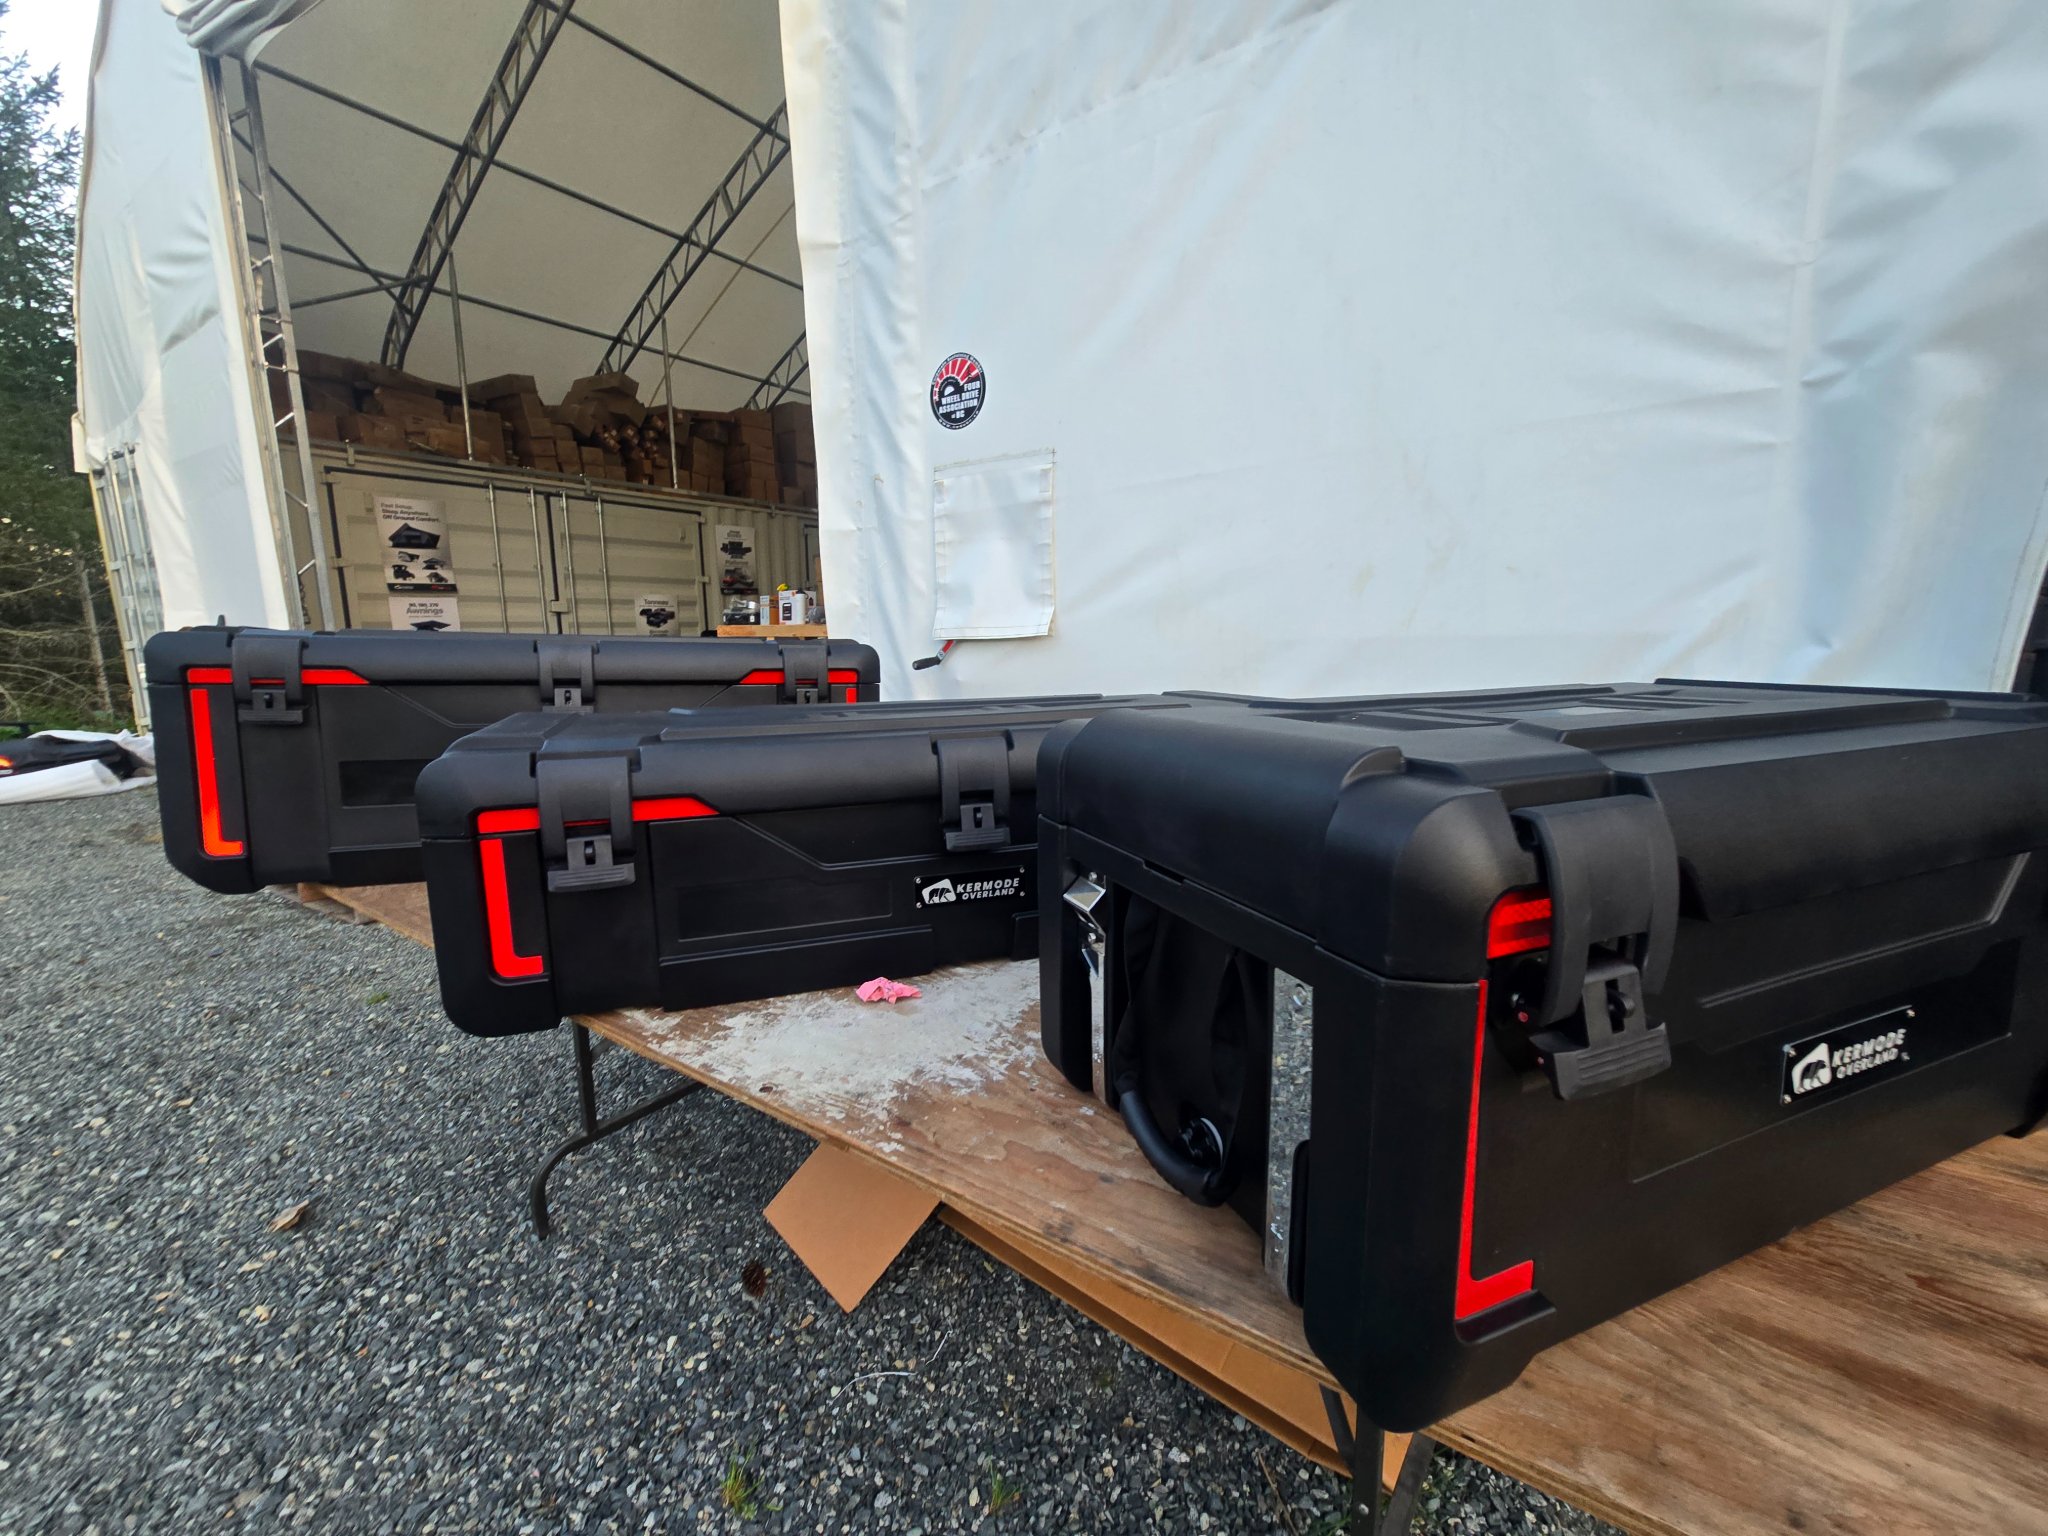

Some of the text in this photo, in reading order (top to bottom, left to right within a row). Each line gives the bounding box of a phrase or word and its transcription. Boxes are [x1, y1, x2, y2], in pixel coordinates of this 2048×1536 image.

[964, 380, 981, 391] FOUR
[941, 389, 979, 405] WHEEL DRIVE
[939, 398, 978, 413] ASSOCIATION
[956, 410, 965, 418] BC
[406, 607, 443, 615] Awnings
[956, 877, 1020, 893] KERMODE
[962, 887, 1015, 900] OVERLAND
[1832, 1028, 1907, 1067] KERMODE
[1837, 1047, 1899, 1078] OVERLAND
